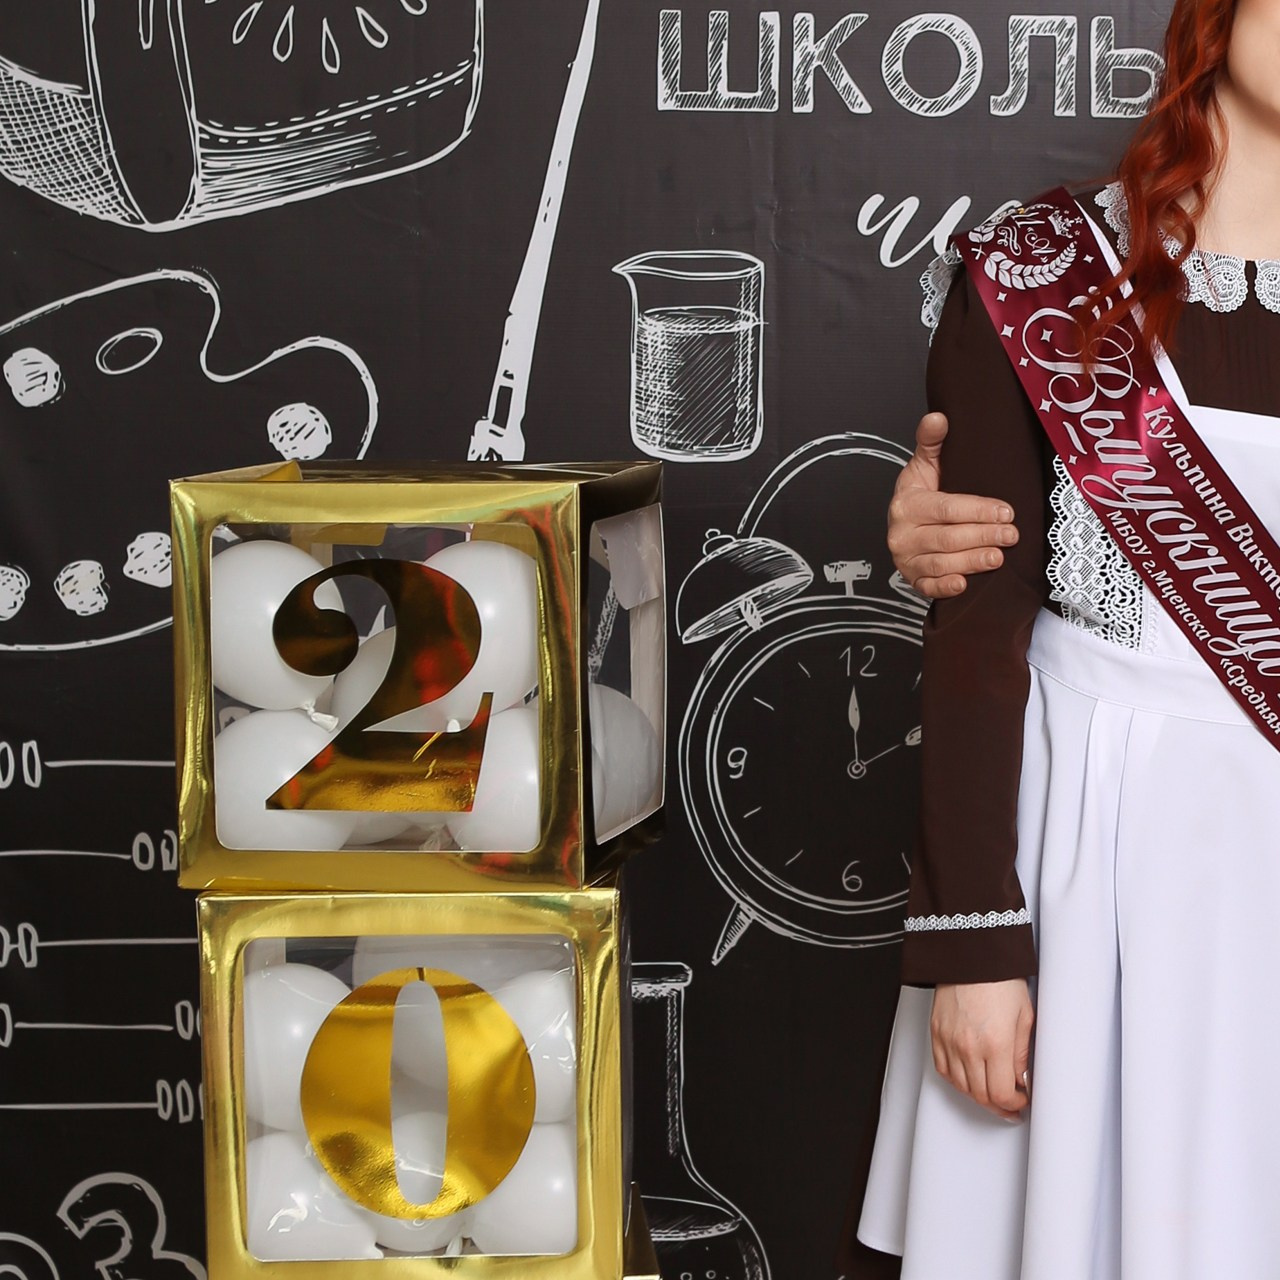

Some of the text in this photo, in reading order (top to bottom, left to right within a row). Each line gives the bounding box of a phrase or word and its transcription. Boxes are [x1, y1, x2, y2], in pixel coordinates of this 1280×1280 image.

[656, 9, 1168, 118] ШКОЛЬ
[1143, 405, 1236, 525] Кульпина
[1106, 510, 1153, 556] МБОУ
[1142, 560, 1211, 642] г.Мценска
[837, 644, 879, 679] 12
[726, 747, 749, 780] 9
[841, 860, 863, 893] 6
